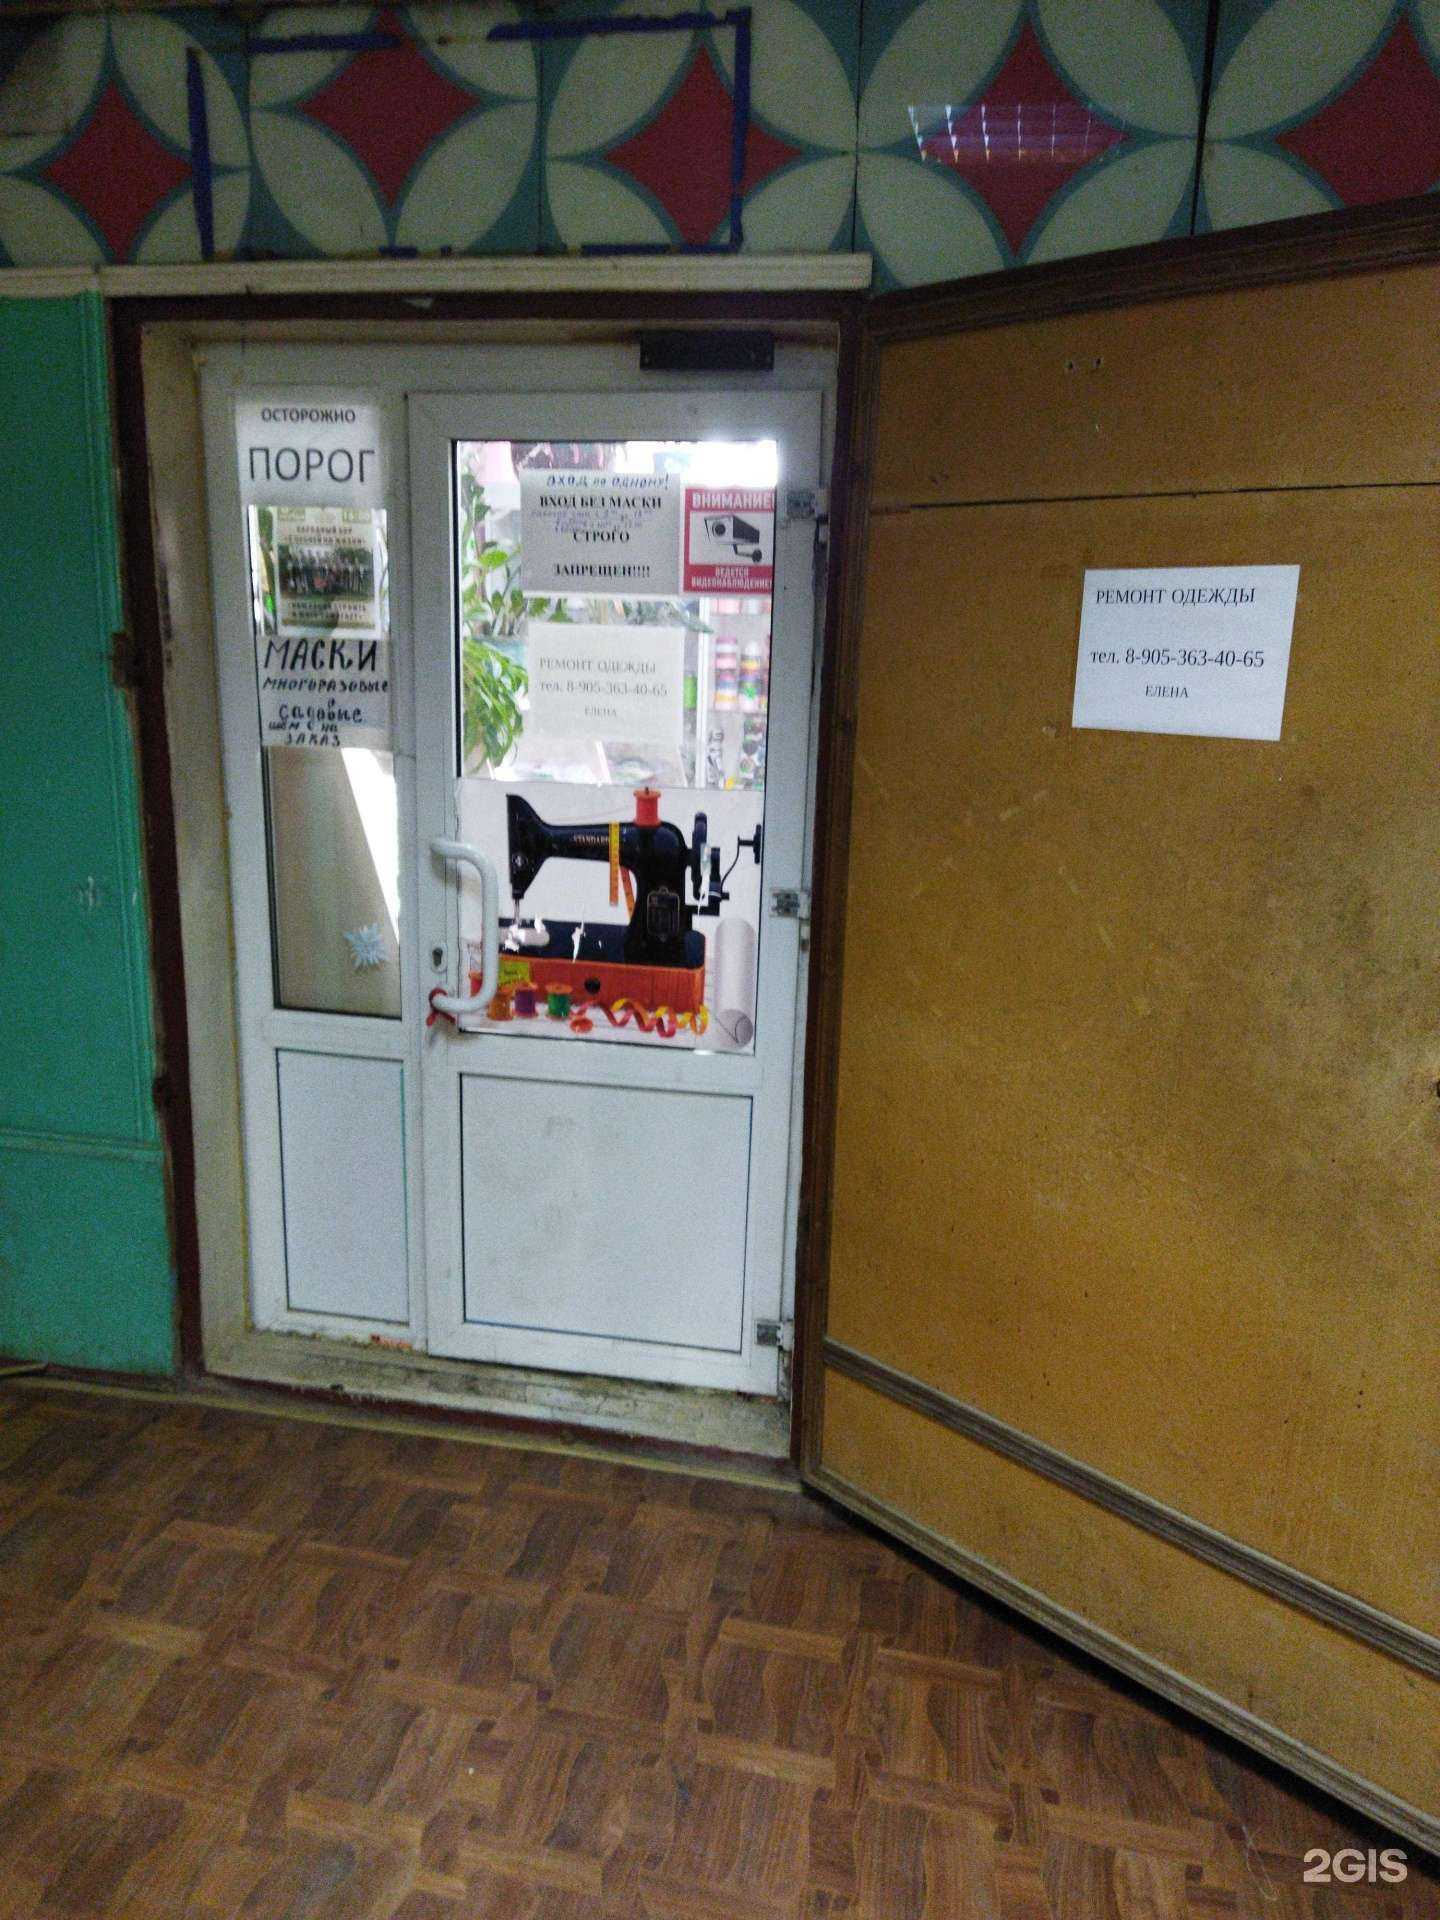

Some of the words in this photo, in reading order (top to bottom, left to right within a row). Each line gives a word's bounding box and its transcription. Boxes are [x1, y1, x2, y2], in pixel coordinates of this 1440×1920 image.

[261, 407, 356, 423] ОСТОРОЖНО
[249, 447, 375, 483] ПОРОГ
[540, 495, 576, 511] ВХОД
[580, 495, 605, 509] БЕЗ
[608, 495, 662, 510] МАСКИ
[573, 529, 630, 544] СТРОГО
[1096, 588, 1167, 605] РЕМОНТ
[1171, 587, 1257, 606] ОДЕЖДЫ
[264, 638, 378, 671] МАСКИ
[1089, 650, 1120, 665] тел.
[1125, 648, 1265, 669] 8-905-363-40-65
[539, 656, 593, 673] РЕМОНТ
[597, 658, 657, 675] ОДЕЖДЫ
[539, 681, 563, 694] тел.
[566, 679, 668, 698] 8-905-363-40-65
[1145, 684, 1190, 699] ЕЛЕНА
[584, 706, 618, 719] ЕЛЕНА
